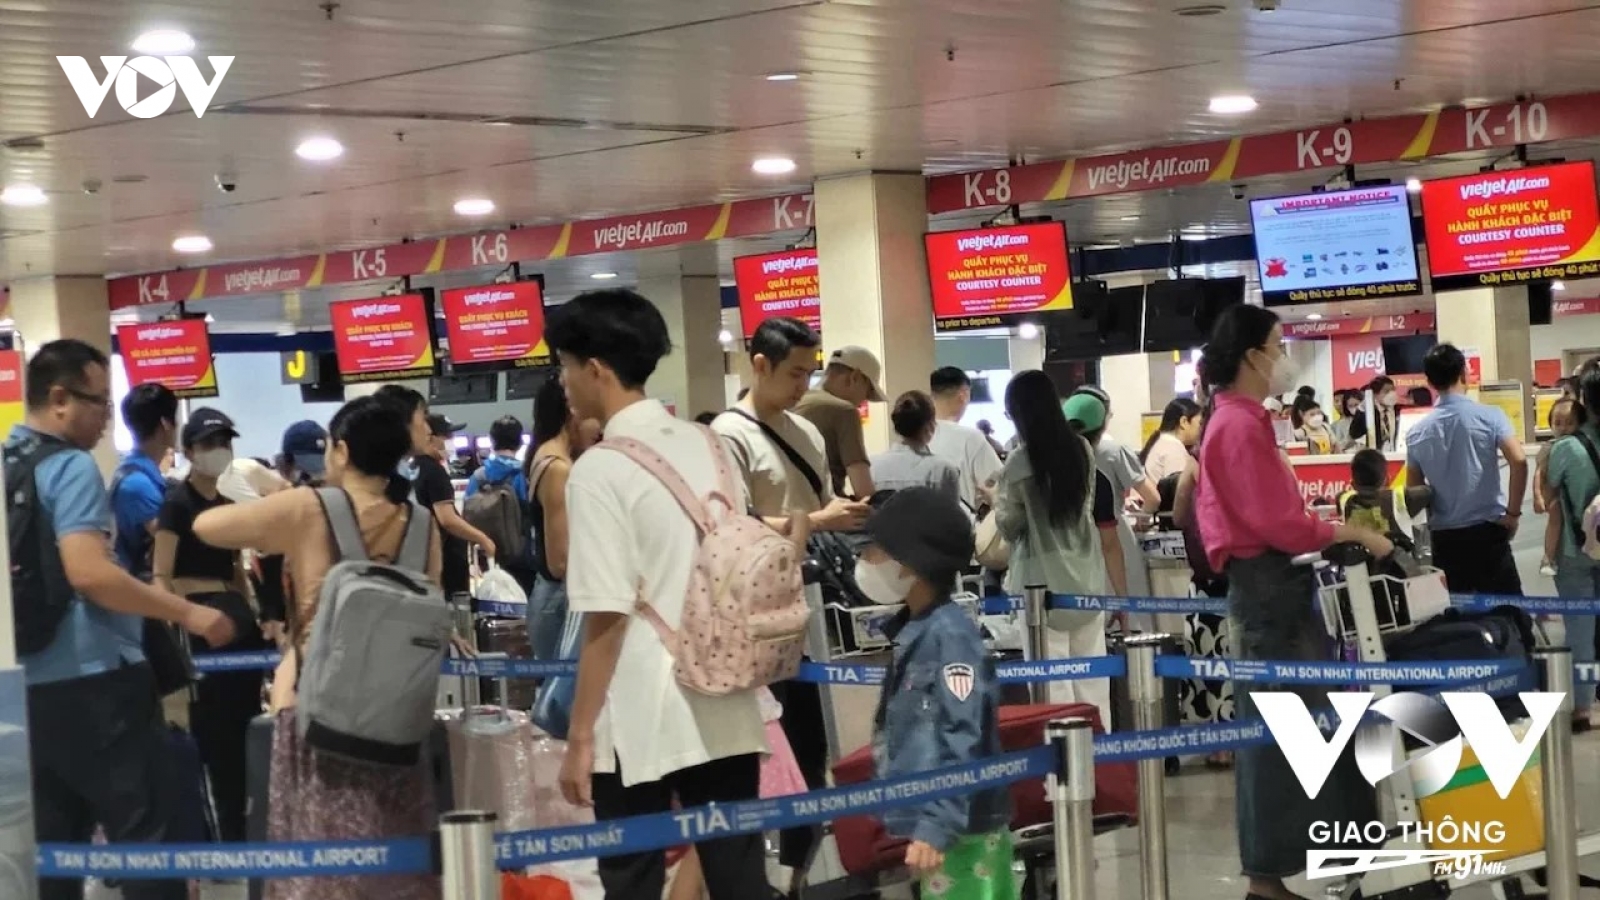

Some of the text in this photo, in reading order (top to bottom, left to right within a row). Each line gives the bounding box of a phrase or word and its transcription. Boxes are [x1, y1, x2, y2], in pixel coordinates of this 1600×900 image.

[1465, 103, 1547, 148] K-10
[1297, 127, 1351, 168] K-9
[964, 169, 1011, 206] K-8
[773, 195, 815, 229] K-7
[1447, 220, 1479, 234] HÀNH
[1482, 215, 1520, 229] KHÁCH
[1459, 224, 1565, 245] COURTESY COUNTER
[472, 233, 507, 265] K-6
[352, 249, 386, 279] K-5
[1566, 264, 1577, 274] 40
[138, 275, 169, 302] K-4
[956, 275, 1041, 291] COURTESY COUNTER
[287, 350, 305, 378] J
[1075, 596, 1102, 609] TIA
[450, 660, 478, 675] TIA
[825, 666, 859, 682] TIA
[1049, 663, 1091, 675] AIRPORT
[1190, 660, 1230, 678] TIA
[1275, 665, 1295, 678] TAN
[1298, 666, 1321, 679] SON
[1324, 666, 1353, 680] NHAT
[1355, 666, 1445, 681] INTERNATIONAL
[1448, 664, 1499, 680] AIRPORT
[1575, 663, 1600, 681] TI
[791, 801, 818, 816] TAN
[820, 796, 847, 812] SON
[849, 788, 883, 806] NHAT
[884, 772, 978, 800] INTERNATIONAL
[979, 758, 1029, 780] AIRPORT
[54, 846, 389, 869] TAN SON NHAT INTERNATIONAL AIRPORT
